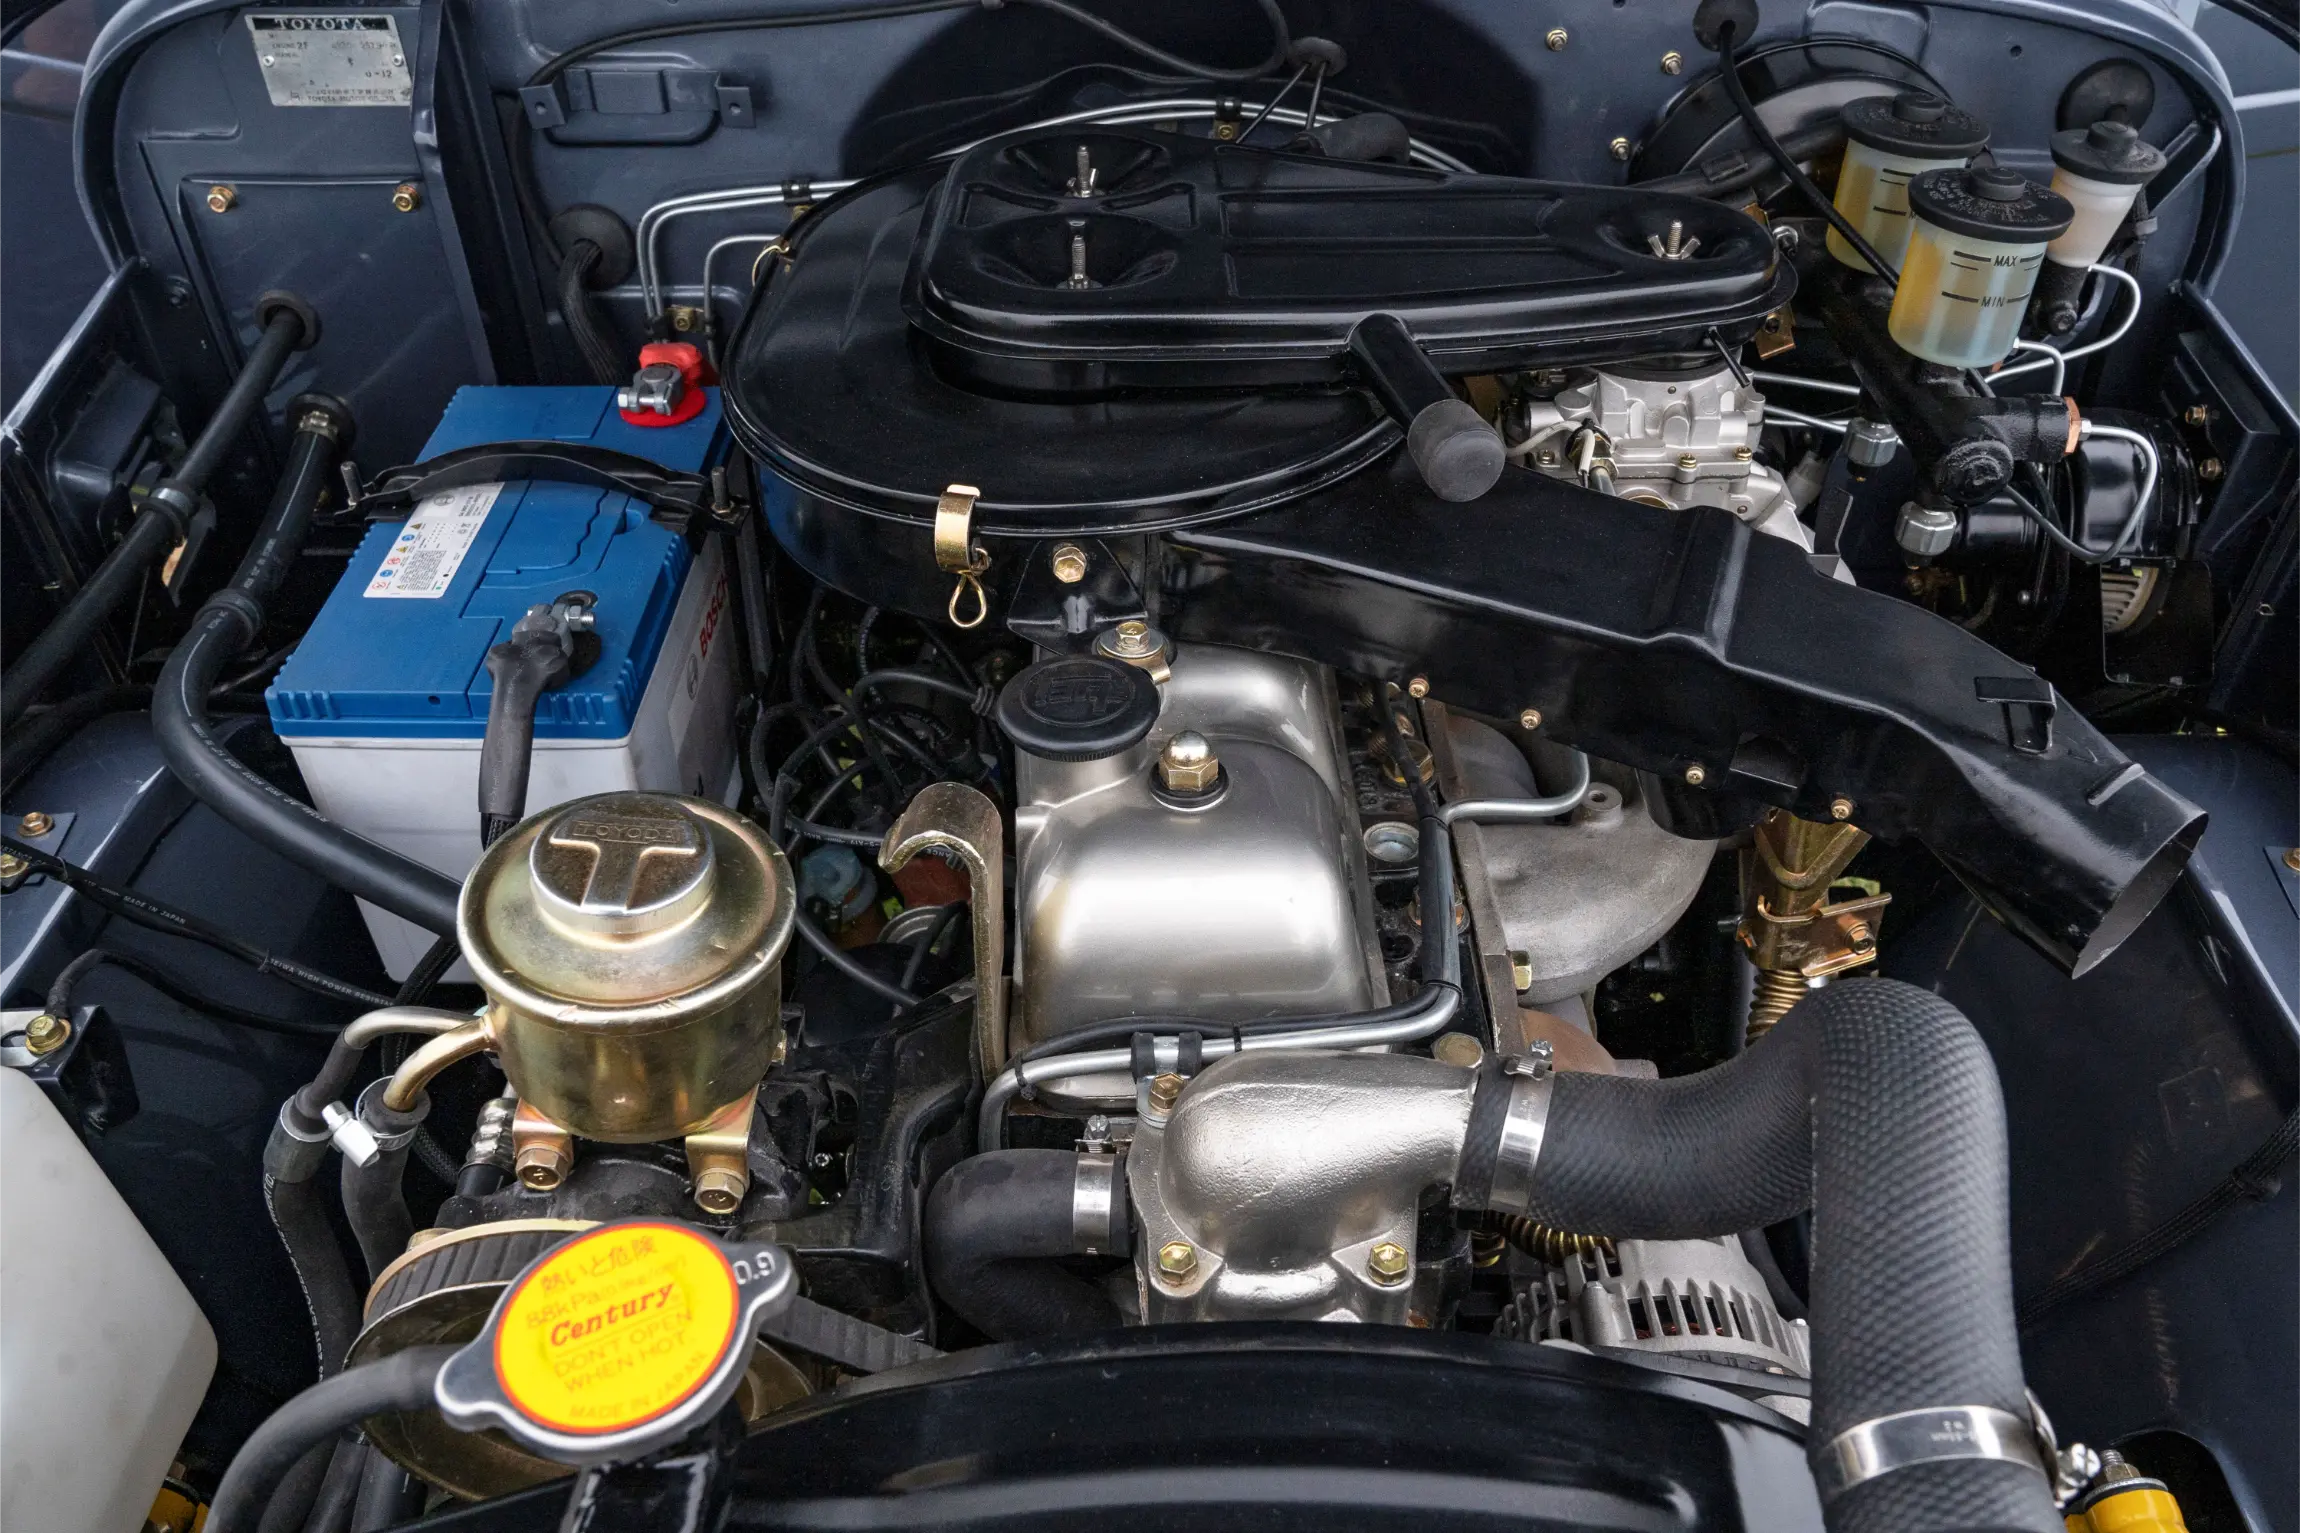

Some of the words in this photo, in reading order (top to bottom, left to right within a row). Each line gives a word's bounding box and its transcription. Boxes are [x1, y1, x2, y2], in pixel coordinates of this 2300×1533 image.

[274, 18, 367, 31] TOYOTA
[1993, 255, 2018, 268] MAX
[1981, 295, 2005, 308] MIN
[579, 822, 675, 840] TOYODA
[123, 894, 145, 908] MADE
[148, 905, 158, 913] IN
[160, 910, 187, 925] JAPAN
[298, 969, 321, 983] HIGH
[322, 979, 353, 995] POWER
[733, 1251, 777, 1285] 0.9
[550, 1282, 675, 1346] Century
[629, 1309, 693, 1344] OPEN
[566, 1356, 634, 1393] WHEN
[640, 1331, 688, 1364] HOT
[657, 1350, 709, 1408] JAPAN
